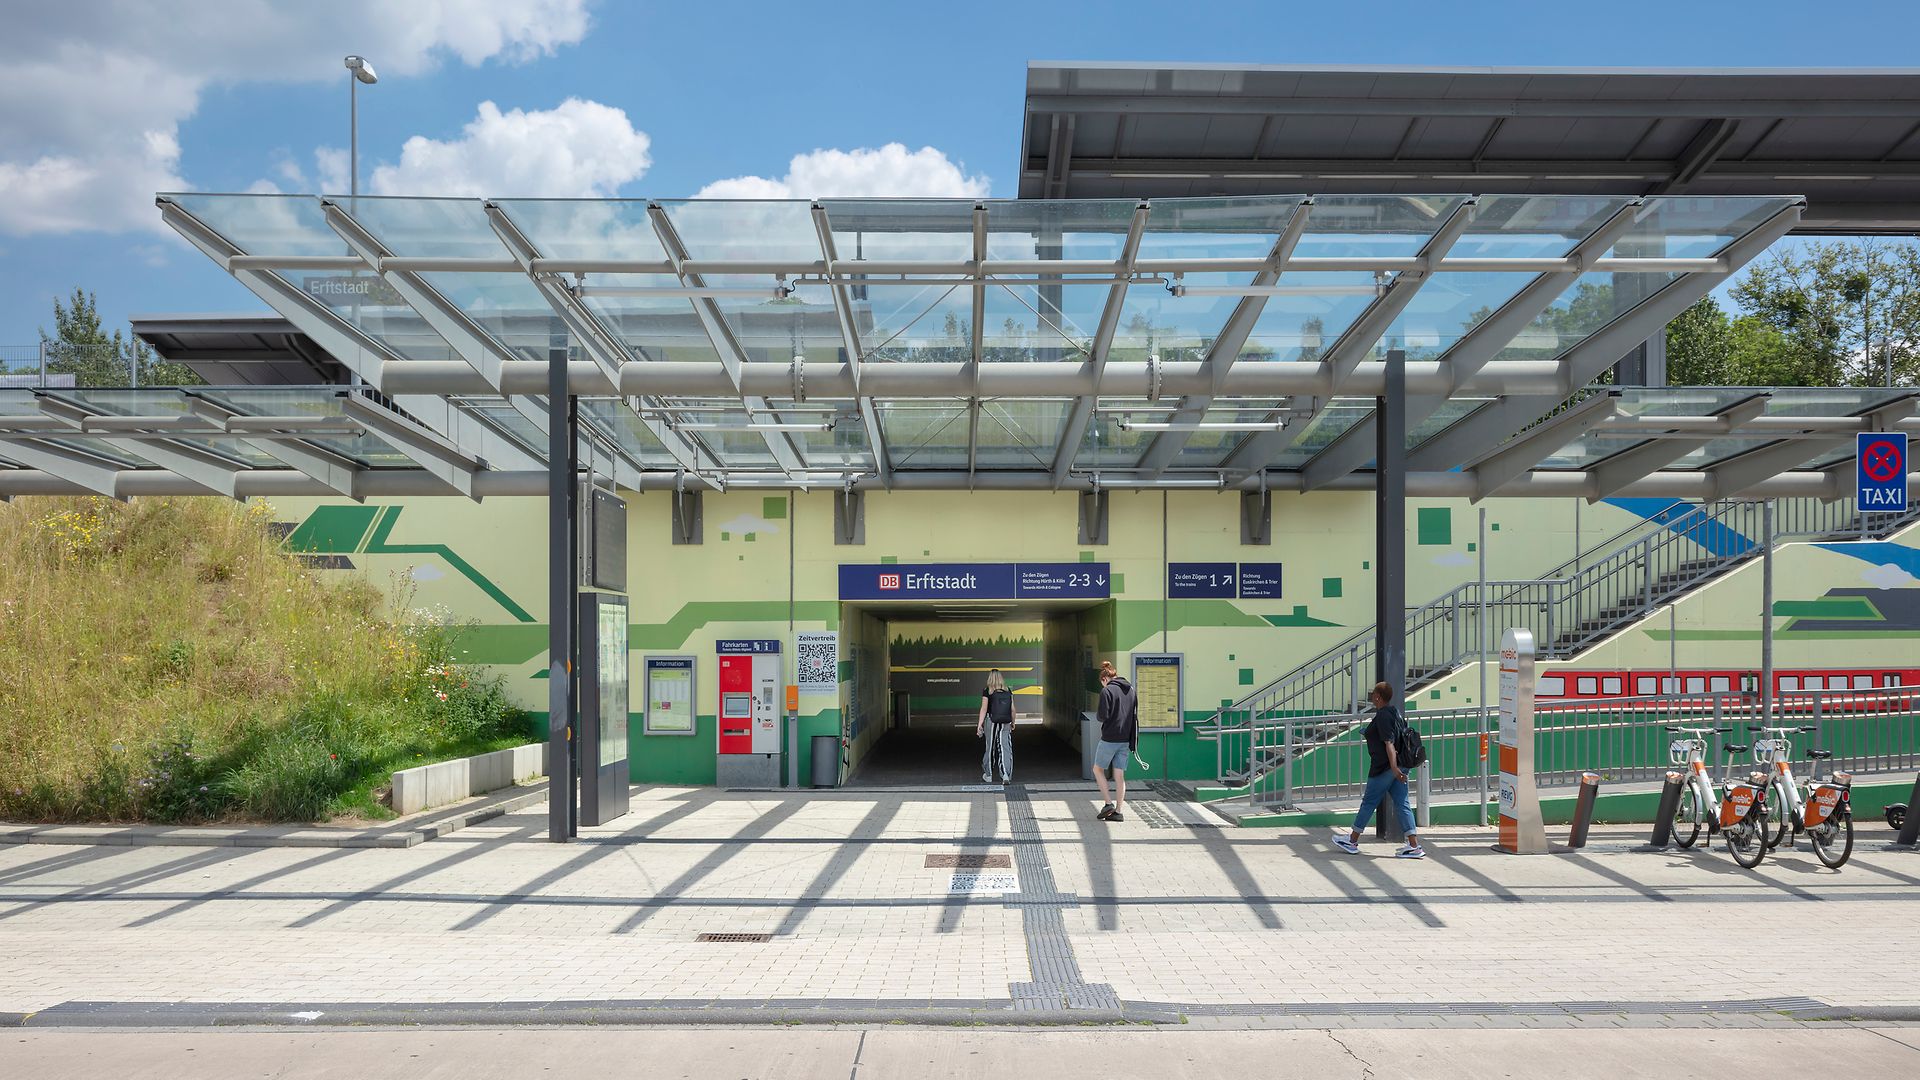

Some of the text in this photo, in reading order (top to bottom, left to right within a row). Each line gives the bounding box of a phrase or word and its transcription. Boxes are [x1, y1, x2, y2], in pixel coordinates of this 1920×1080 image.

[311, 280, 369, 294] Erftstadt
[1862, 488, 1902, 504] TAXI
[881, 573, 977, 589] DB Erftstadt
[1069, 573, 1091, 587] 2-3
[1210, 574, 1217, 587] 1
